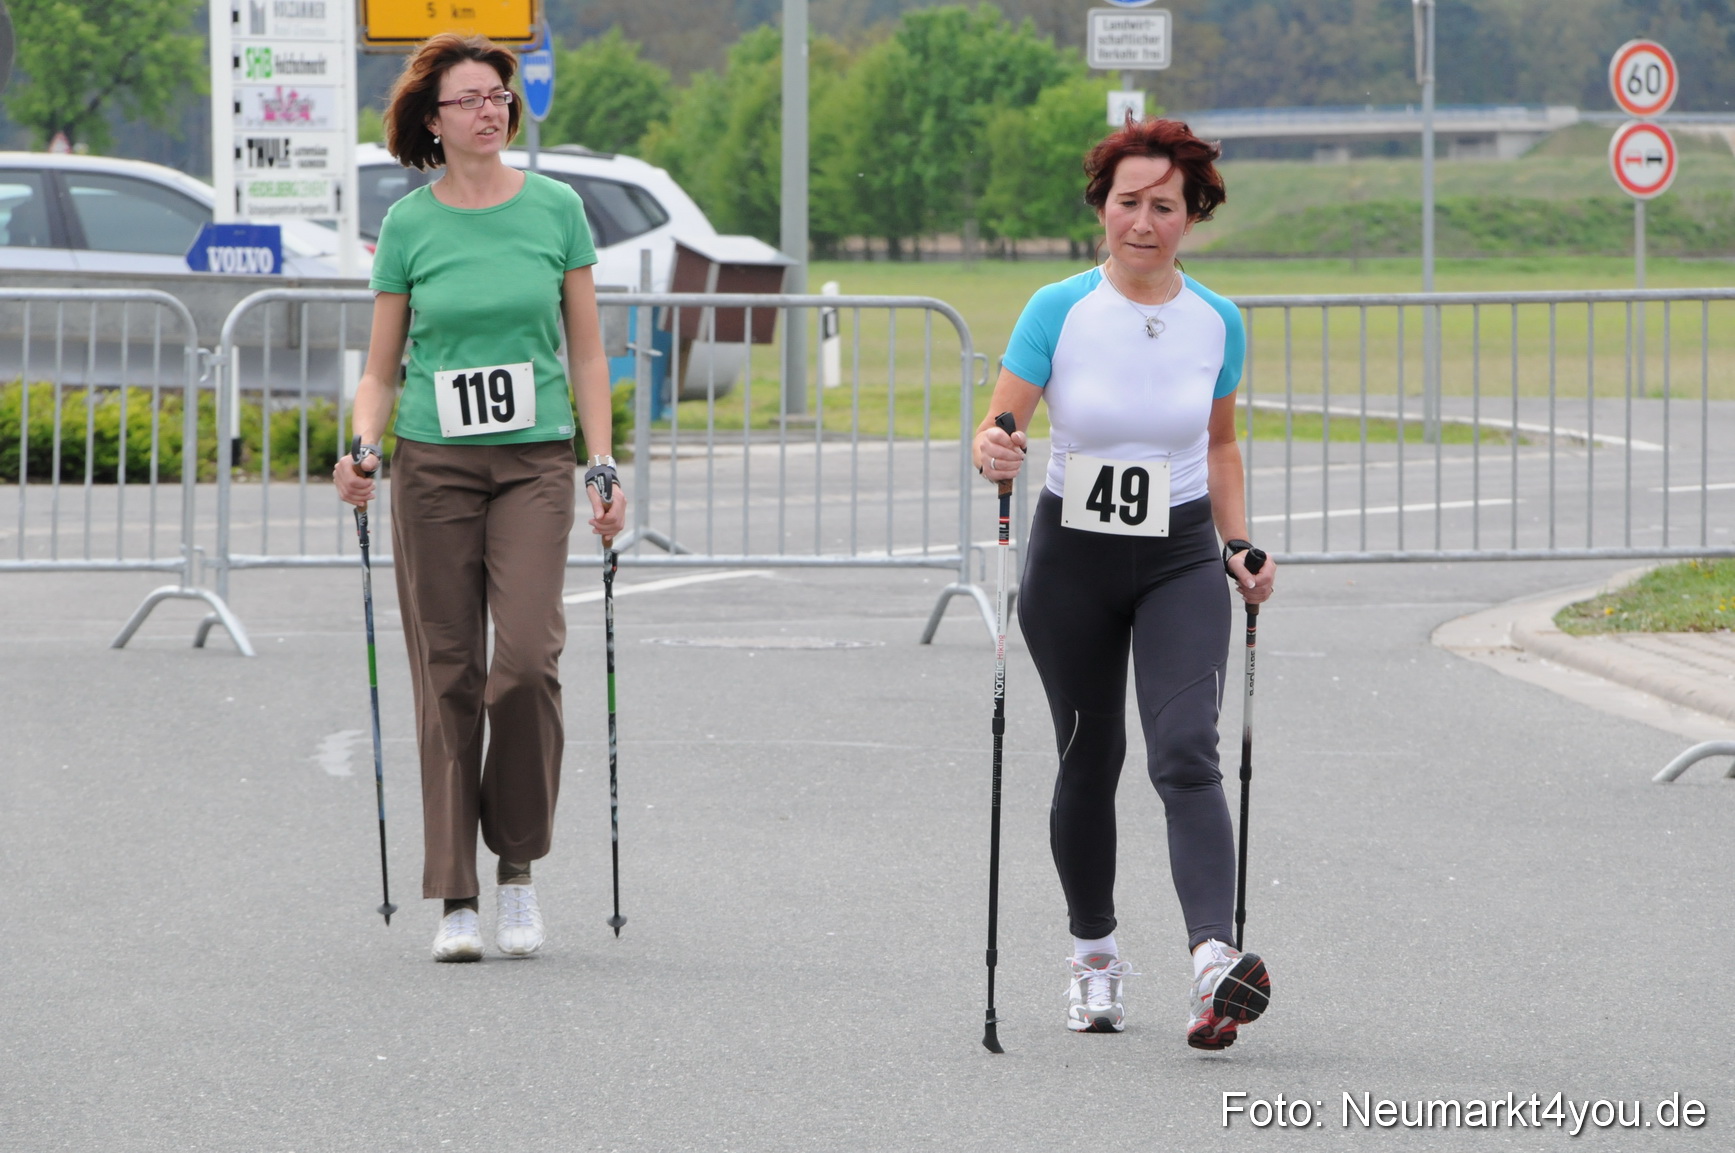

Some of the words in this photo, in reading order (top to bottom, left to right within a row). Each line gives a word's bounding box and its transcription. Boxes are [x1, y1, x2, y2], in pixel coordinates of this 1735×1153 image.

[426, 2, 437, 19] 5
[451, 5, 476, 19] km
[1103, 18, 1156, 31] Landwirt-
[1098, 33, 1161, 46] schaftlicher
[1628, 63, 1661, 95] 60
[247, 138, 290, 168] THULE
[206, 246, 274, 274] VOLVO
[452, 369, 515, 426] 119
[1086, 465, 1149, 526] 49
